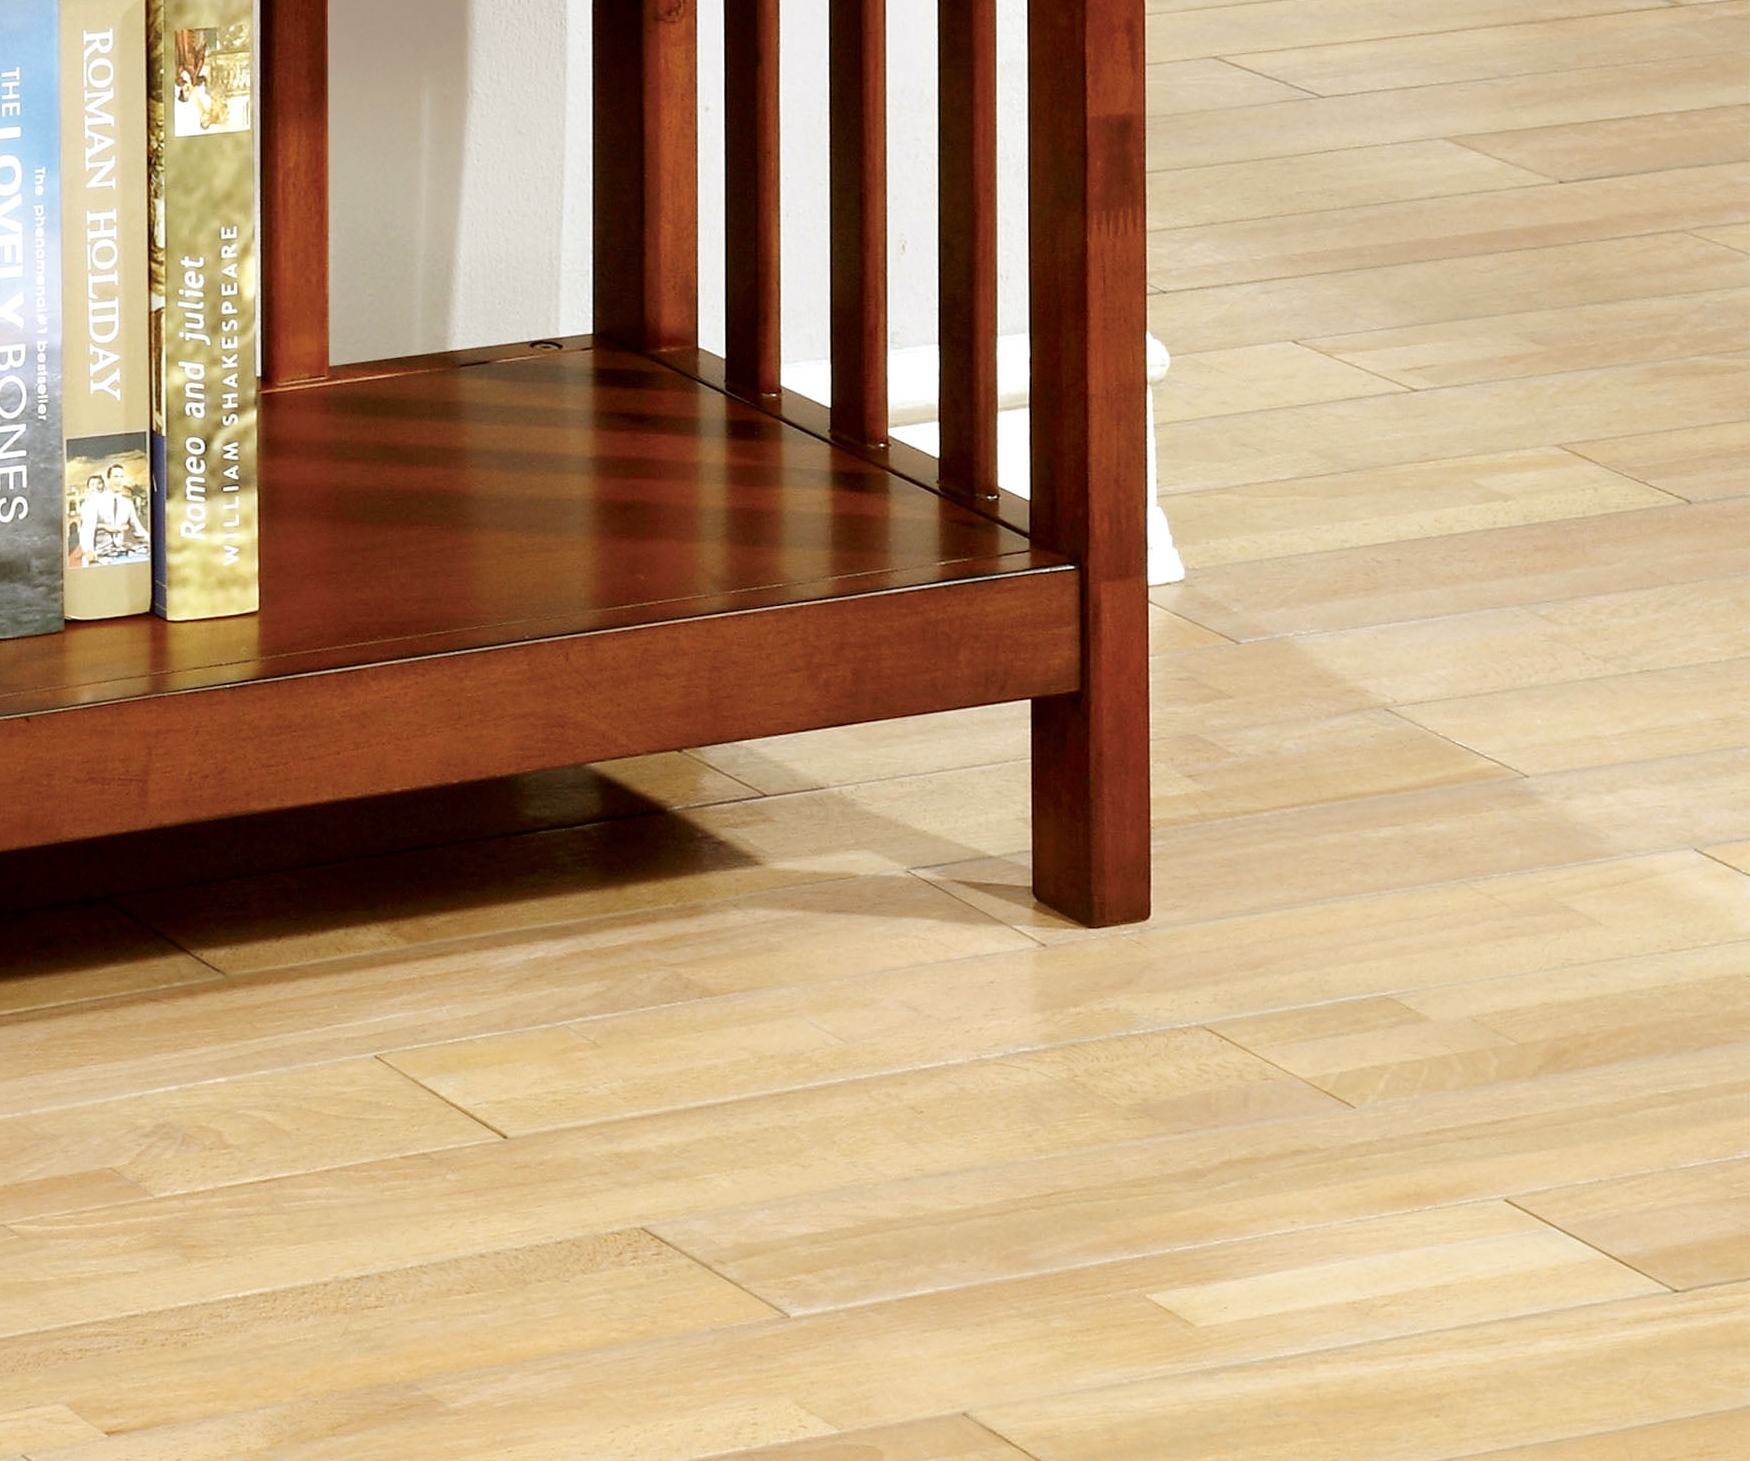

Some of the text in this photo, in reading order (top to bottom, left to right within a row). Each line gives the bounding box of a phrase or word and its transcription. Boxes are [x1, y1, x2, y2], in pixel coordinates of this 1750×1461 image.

[0, 67, 21, 117] THE
[33, 166, 47, 196] The
[82, 27, 122, 402] ROMAN HOLIDAY
[36, 340, 49, 421] bestseller
[178, 256, 211, 539] Romeo and juliet
[220, 225, 240, 566] WILLIAM SHAKESPEARE
